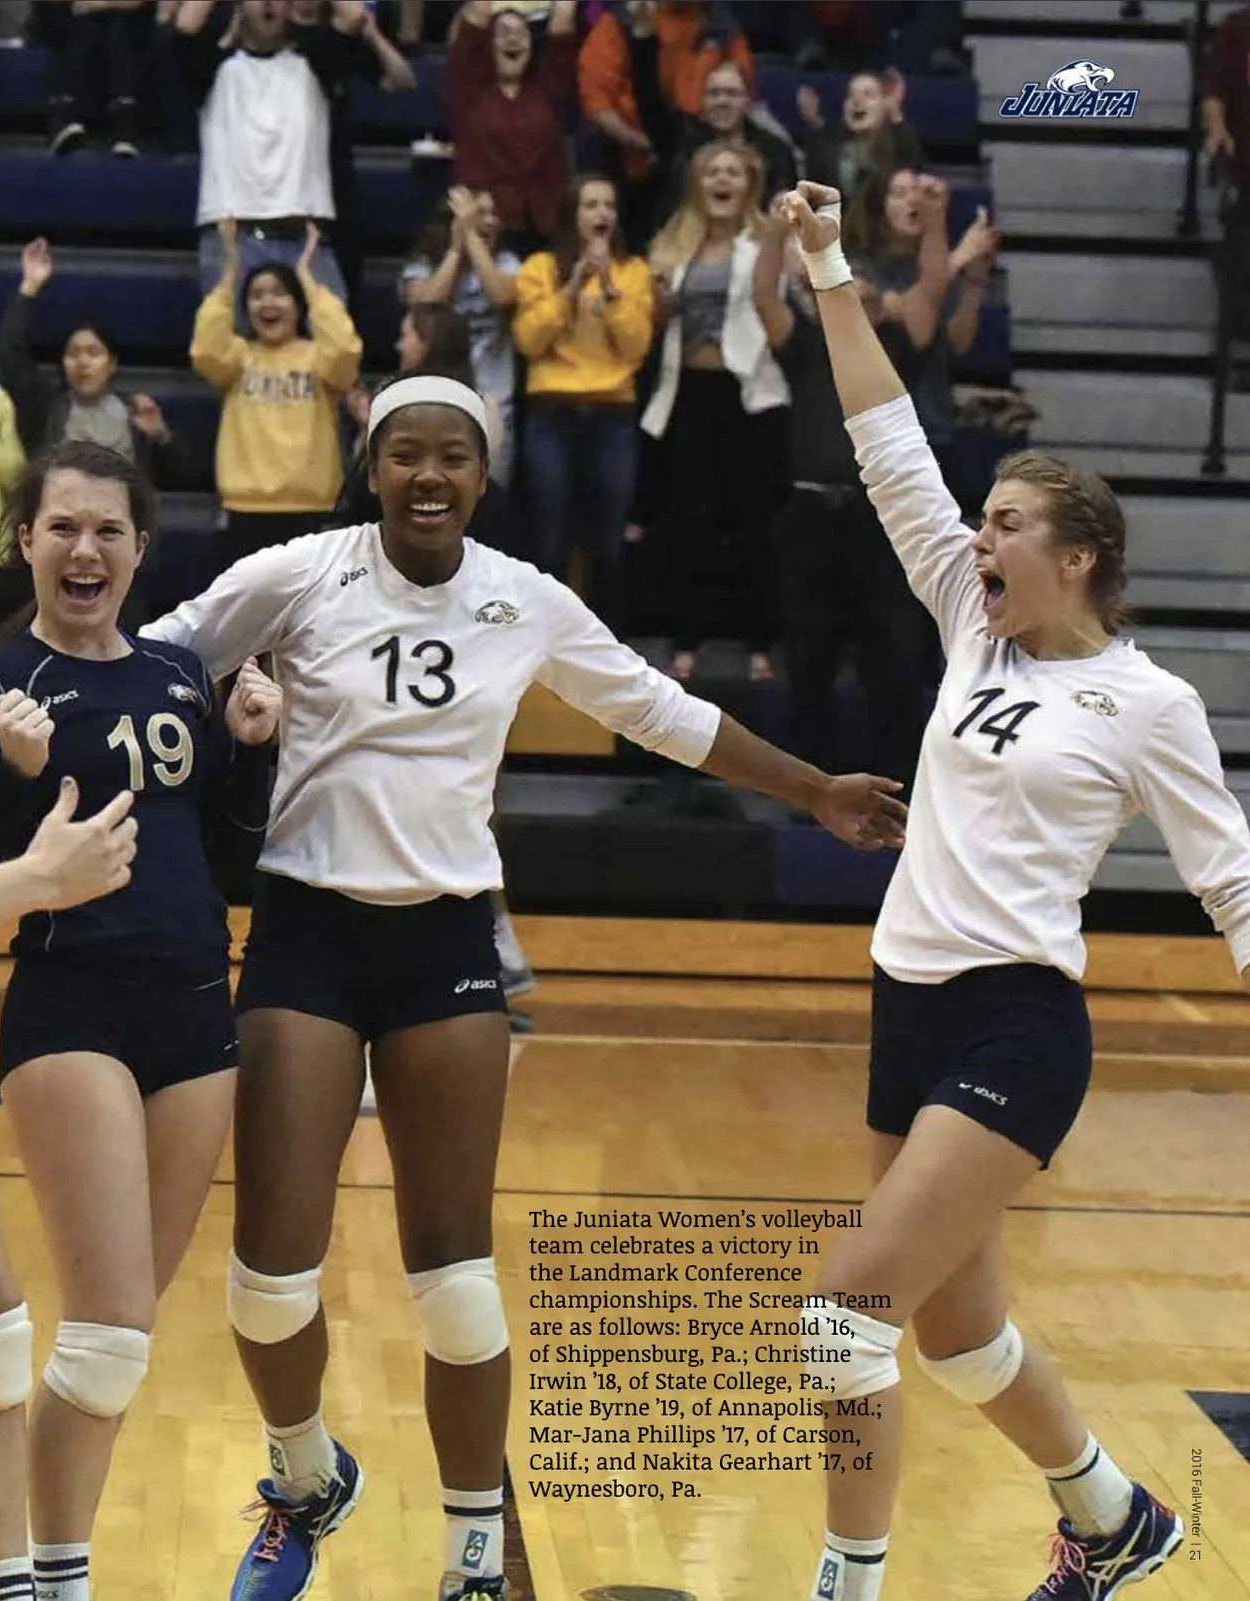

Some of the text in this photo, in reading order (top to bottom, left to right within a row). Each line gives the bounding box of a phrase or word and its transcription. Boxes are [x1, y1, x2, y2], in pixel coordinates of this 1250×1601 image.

[370, 635, 456, 708] 13
[106, 712, 194, 791] 19
[951, 687, 1041, 755] 14
[973, 1086, 1008, 1106] asics
